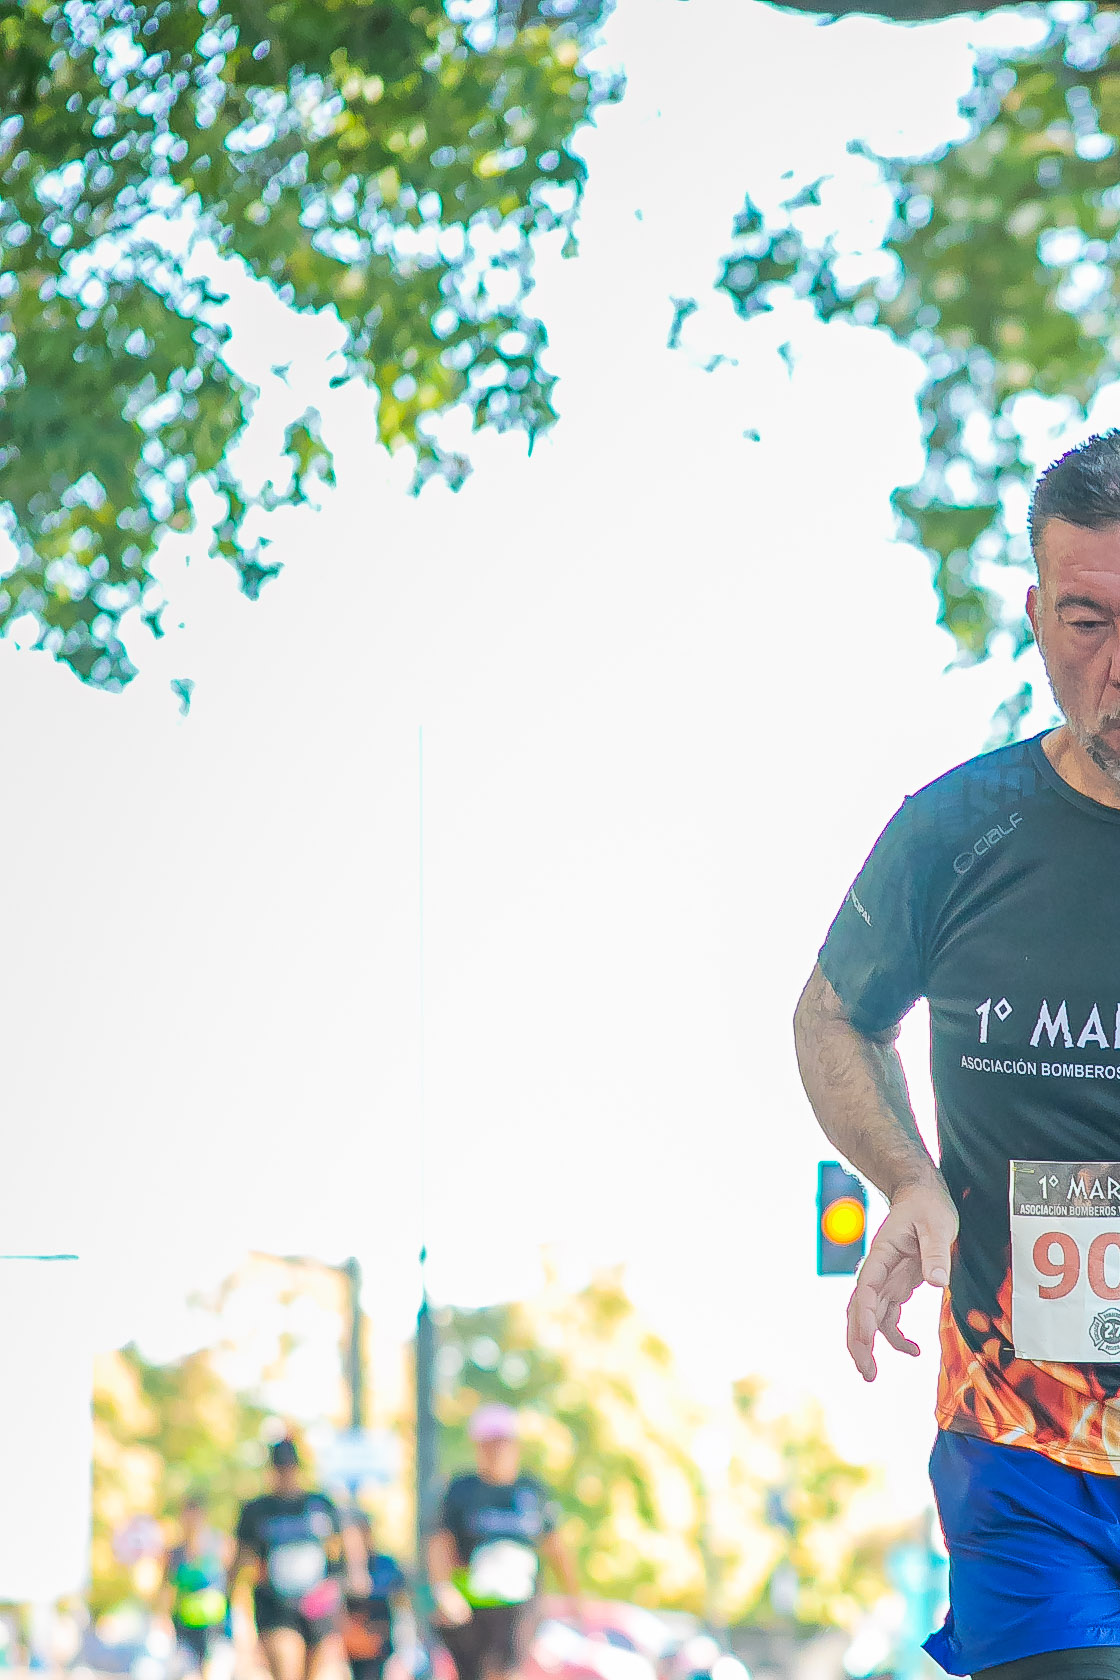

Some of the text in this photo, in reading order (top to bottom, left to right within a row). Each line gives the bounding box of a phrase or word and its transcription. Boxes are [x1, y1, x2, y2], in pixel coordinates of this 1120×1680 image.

[960, 1054, 1037, 1076] ASOCIACIÓN
[1019, 1203, 1068, 1216] ASOCIACIÓN
[1069, 1204, 1117, 1217] BOMBEROS
